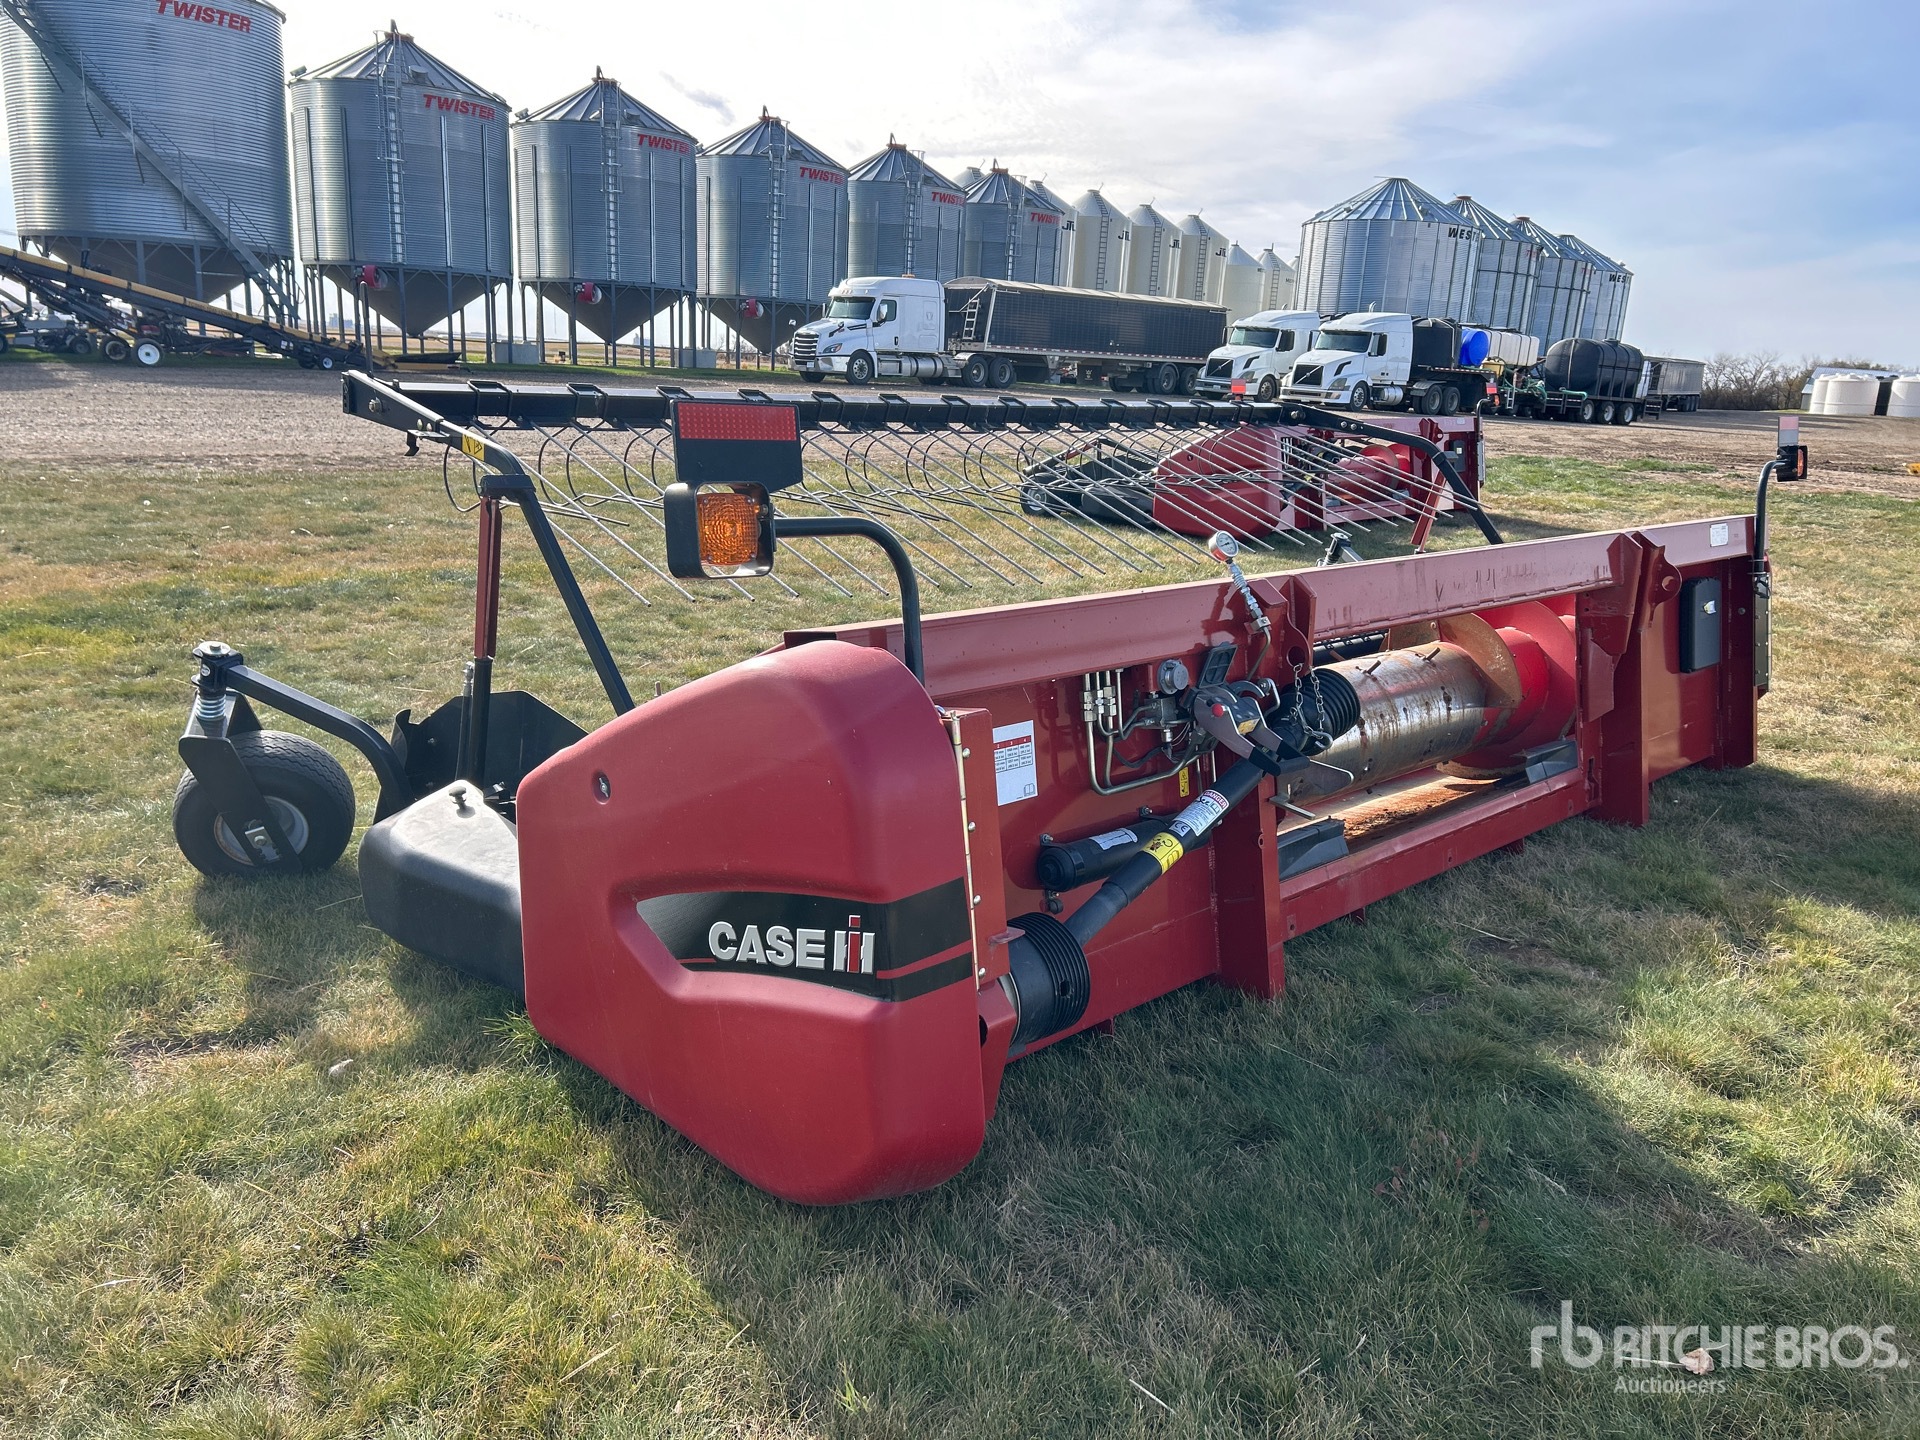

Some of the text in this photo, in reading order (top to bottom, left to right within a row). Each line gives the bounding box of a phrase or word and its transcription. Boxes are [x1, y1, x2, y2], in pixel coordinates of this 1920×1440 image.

[156, 0, 251, 33] TWISTER
[423, 93, 496, 119] TWISTER
[1203, 790, 1228, 809] DANGER
[708, 921, 826, 971] CASE
